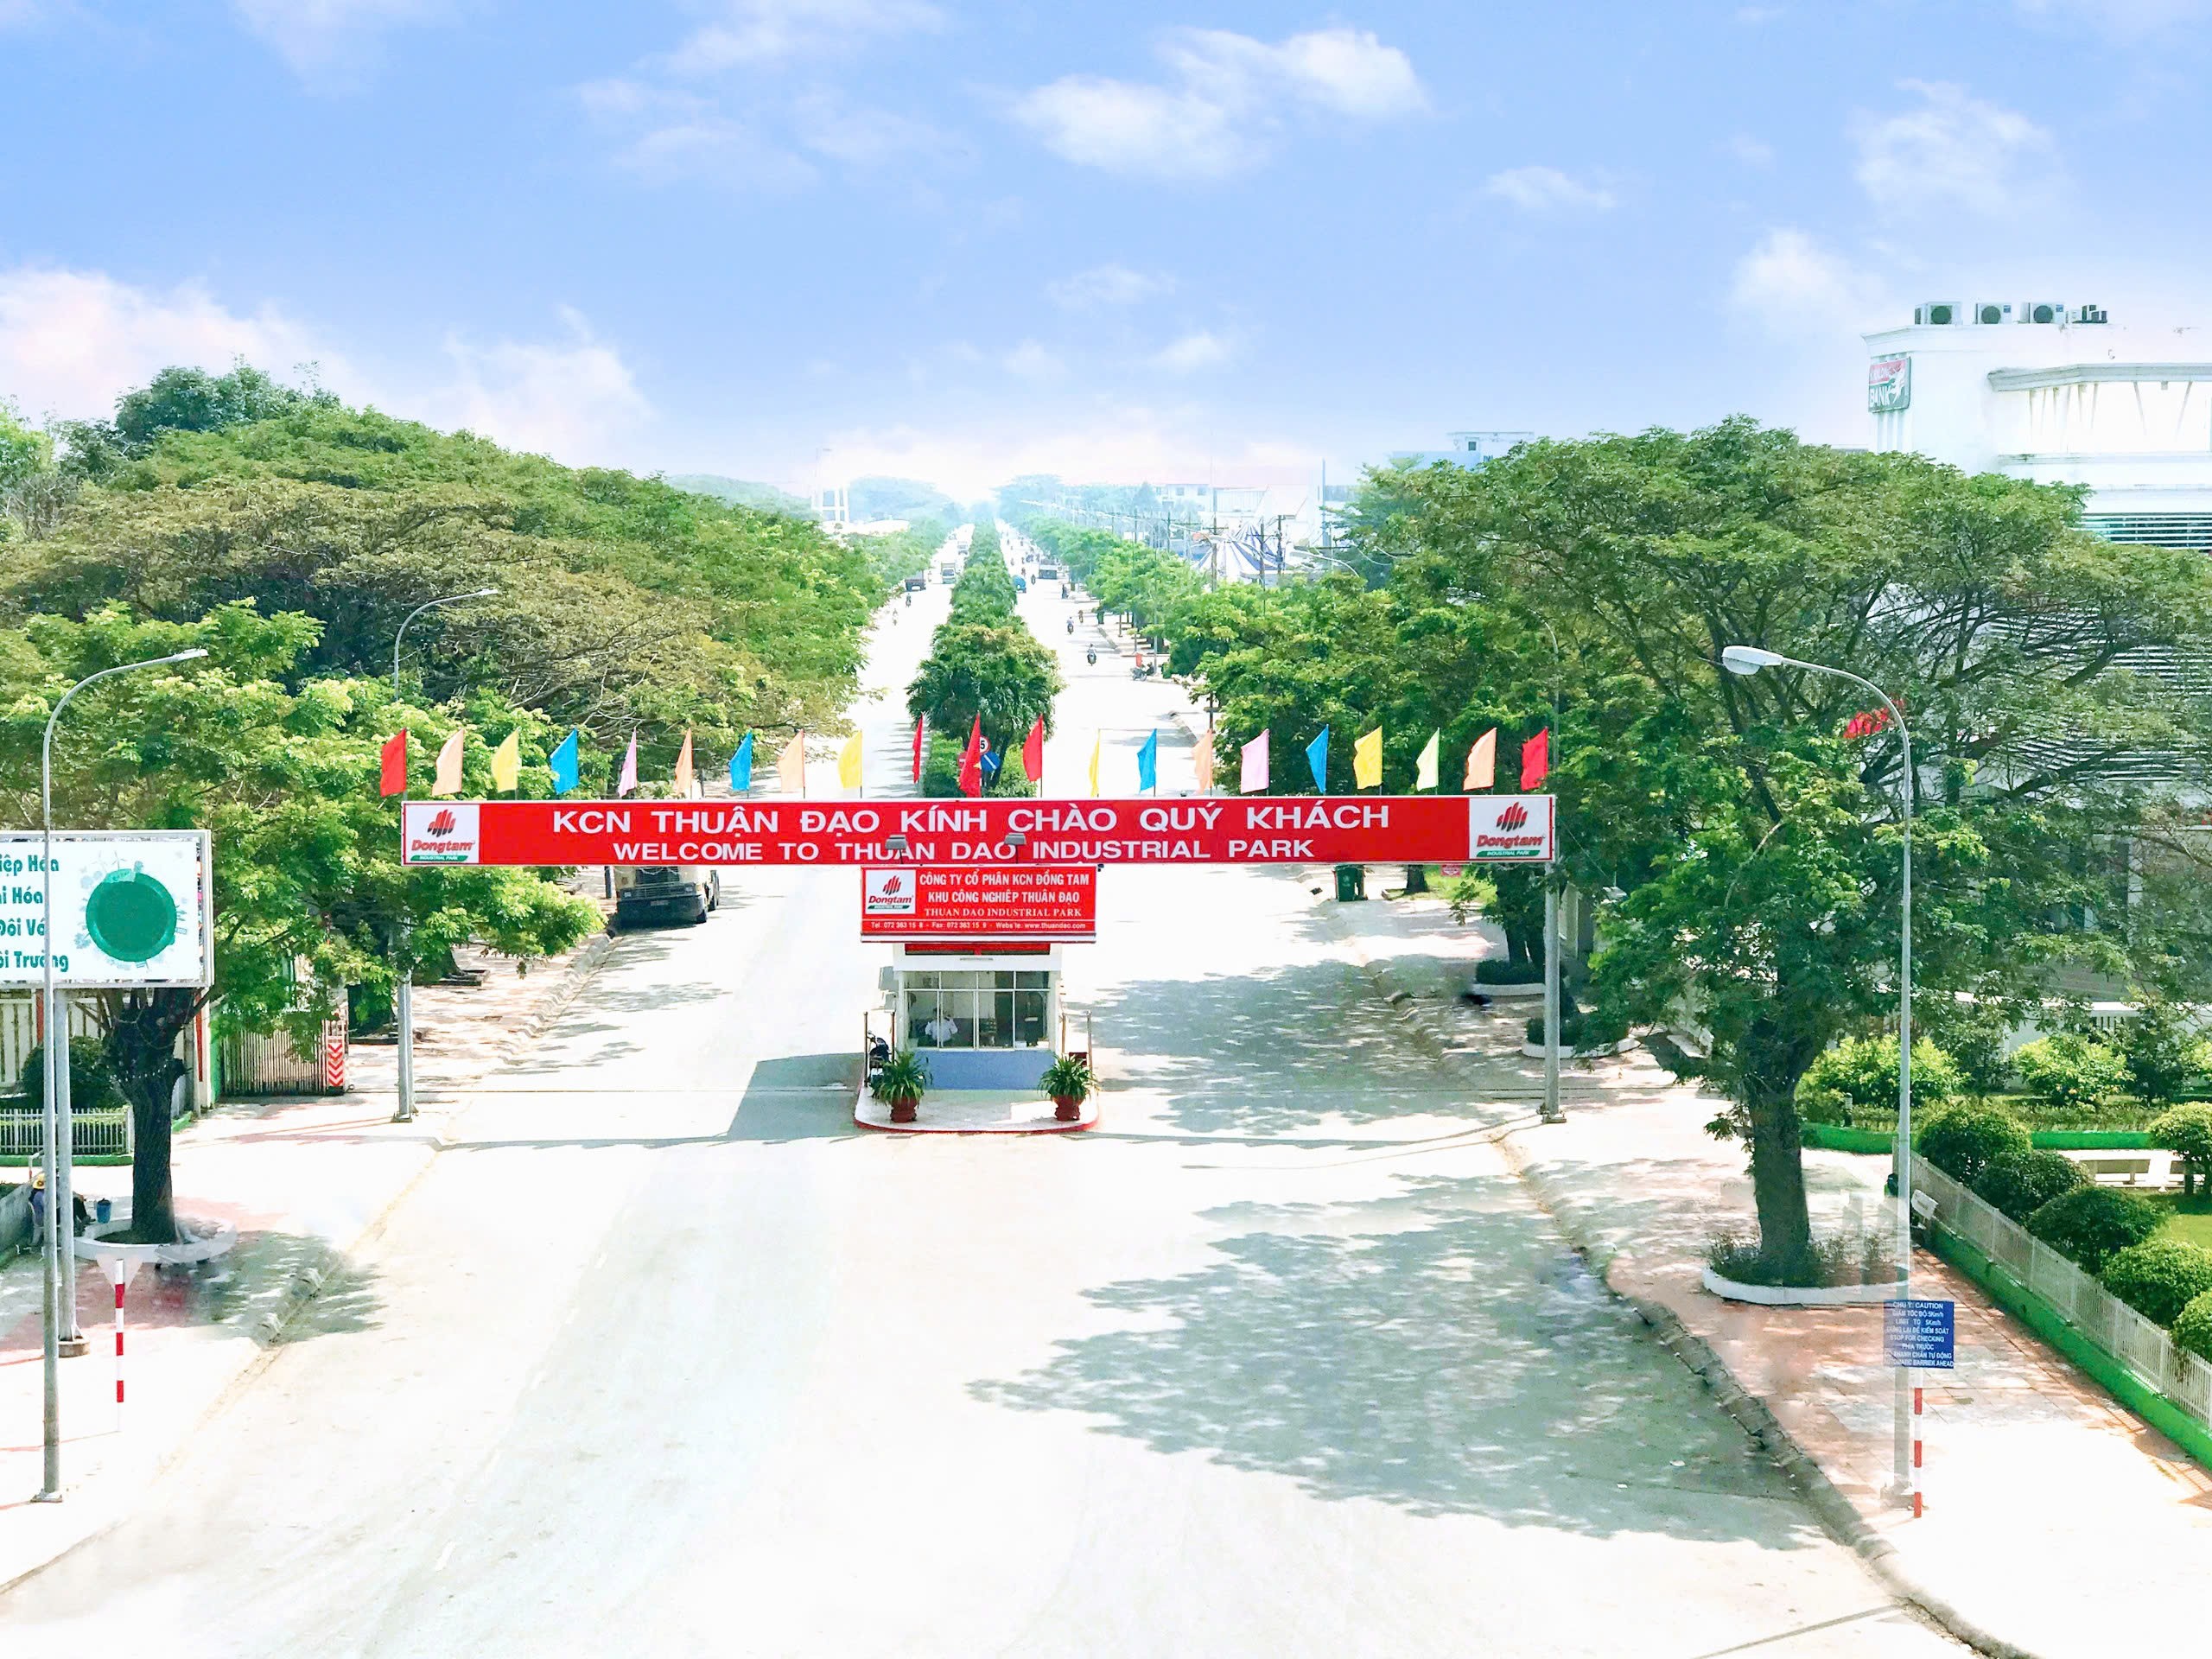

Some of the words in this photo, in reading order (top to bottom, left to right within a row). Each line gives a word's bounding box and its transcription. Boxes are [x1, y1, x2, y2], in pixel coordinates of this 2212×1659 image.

[552, 810, 632, 834] KCN
[651, 805, 778, 837] THUẬN
[800, 810, 880, 836] ĐẠO
[900, 804, 987, 833] KÍNH
[1007, 803, 1117, 832] CHÀO
[1139, 802, 1224, 832] QUÝ
[1246, 800, 1389, 830] KHÁCH
[411, 839, 473, 854] Dongtam
[1477, 835, 1543, 849] Dongtam
[613, 842, 762, 861] WELCOME
[778, 842, 820, 860] TO
[835, 842, 935, 860] THUAN
[951, 842, 1017, 860] DAO
[1033, 841, 1211, 860] INDUSTRIAL
[1229, 840, 1314, 858] PARK
[919, 871, 947, 886] CÔNG
[950, 874, 963, 886] TY
[1012, 874, 1033, 886] KCN
[12, 886, 43, 904] Hóa
[868, 895, 912, 906] Dongtam
[928, 891, 949, 903] KHU
[951, 888, 979, 903] CÔNG
[1058, 891, 1080, 906] ĐẠO
[924, 908, 960, 917] THUAN
[963, 908, 984, 917] DAO
[988, 908, 1050, 917] INDUSTRIAL
[1053, 908, 1082, 917] PARK
